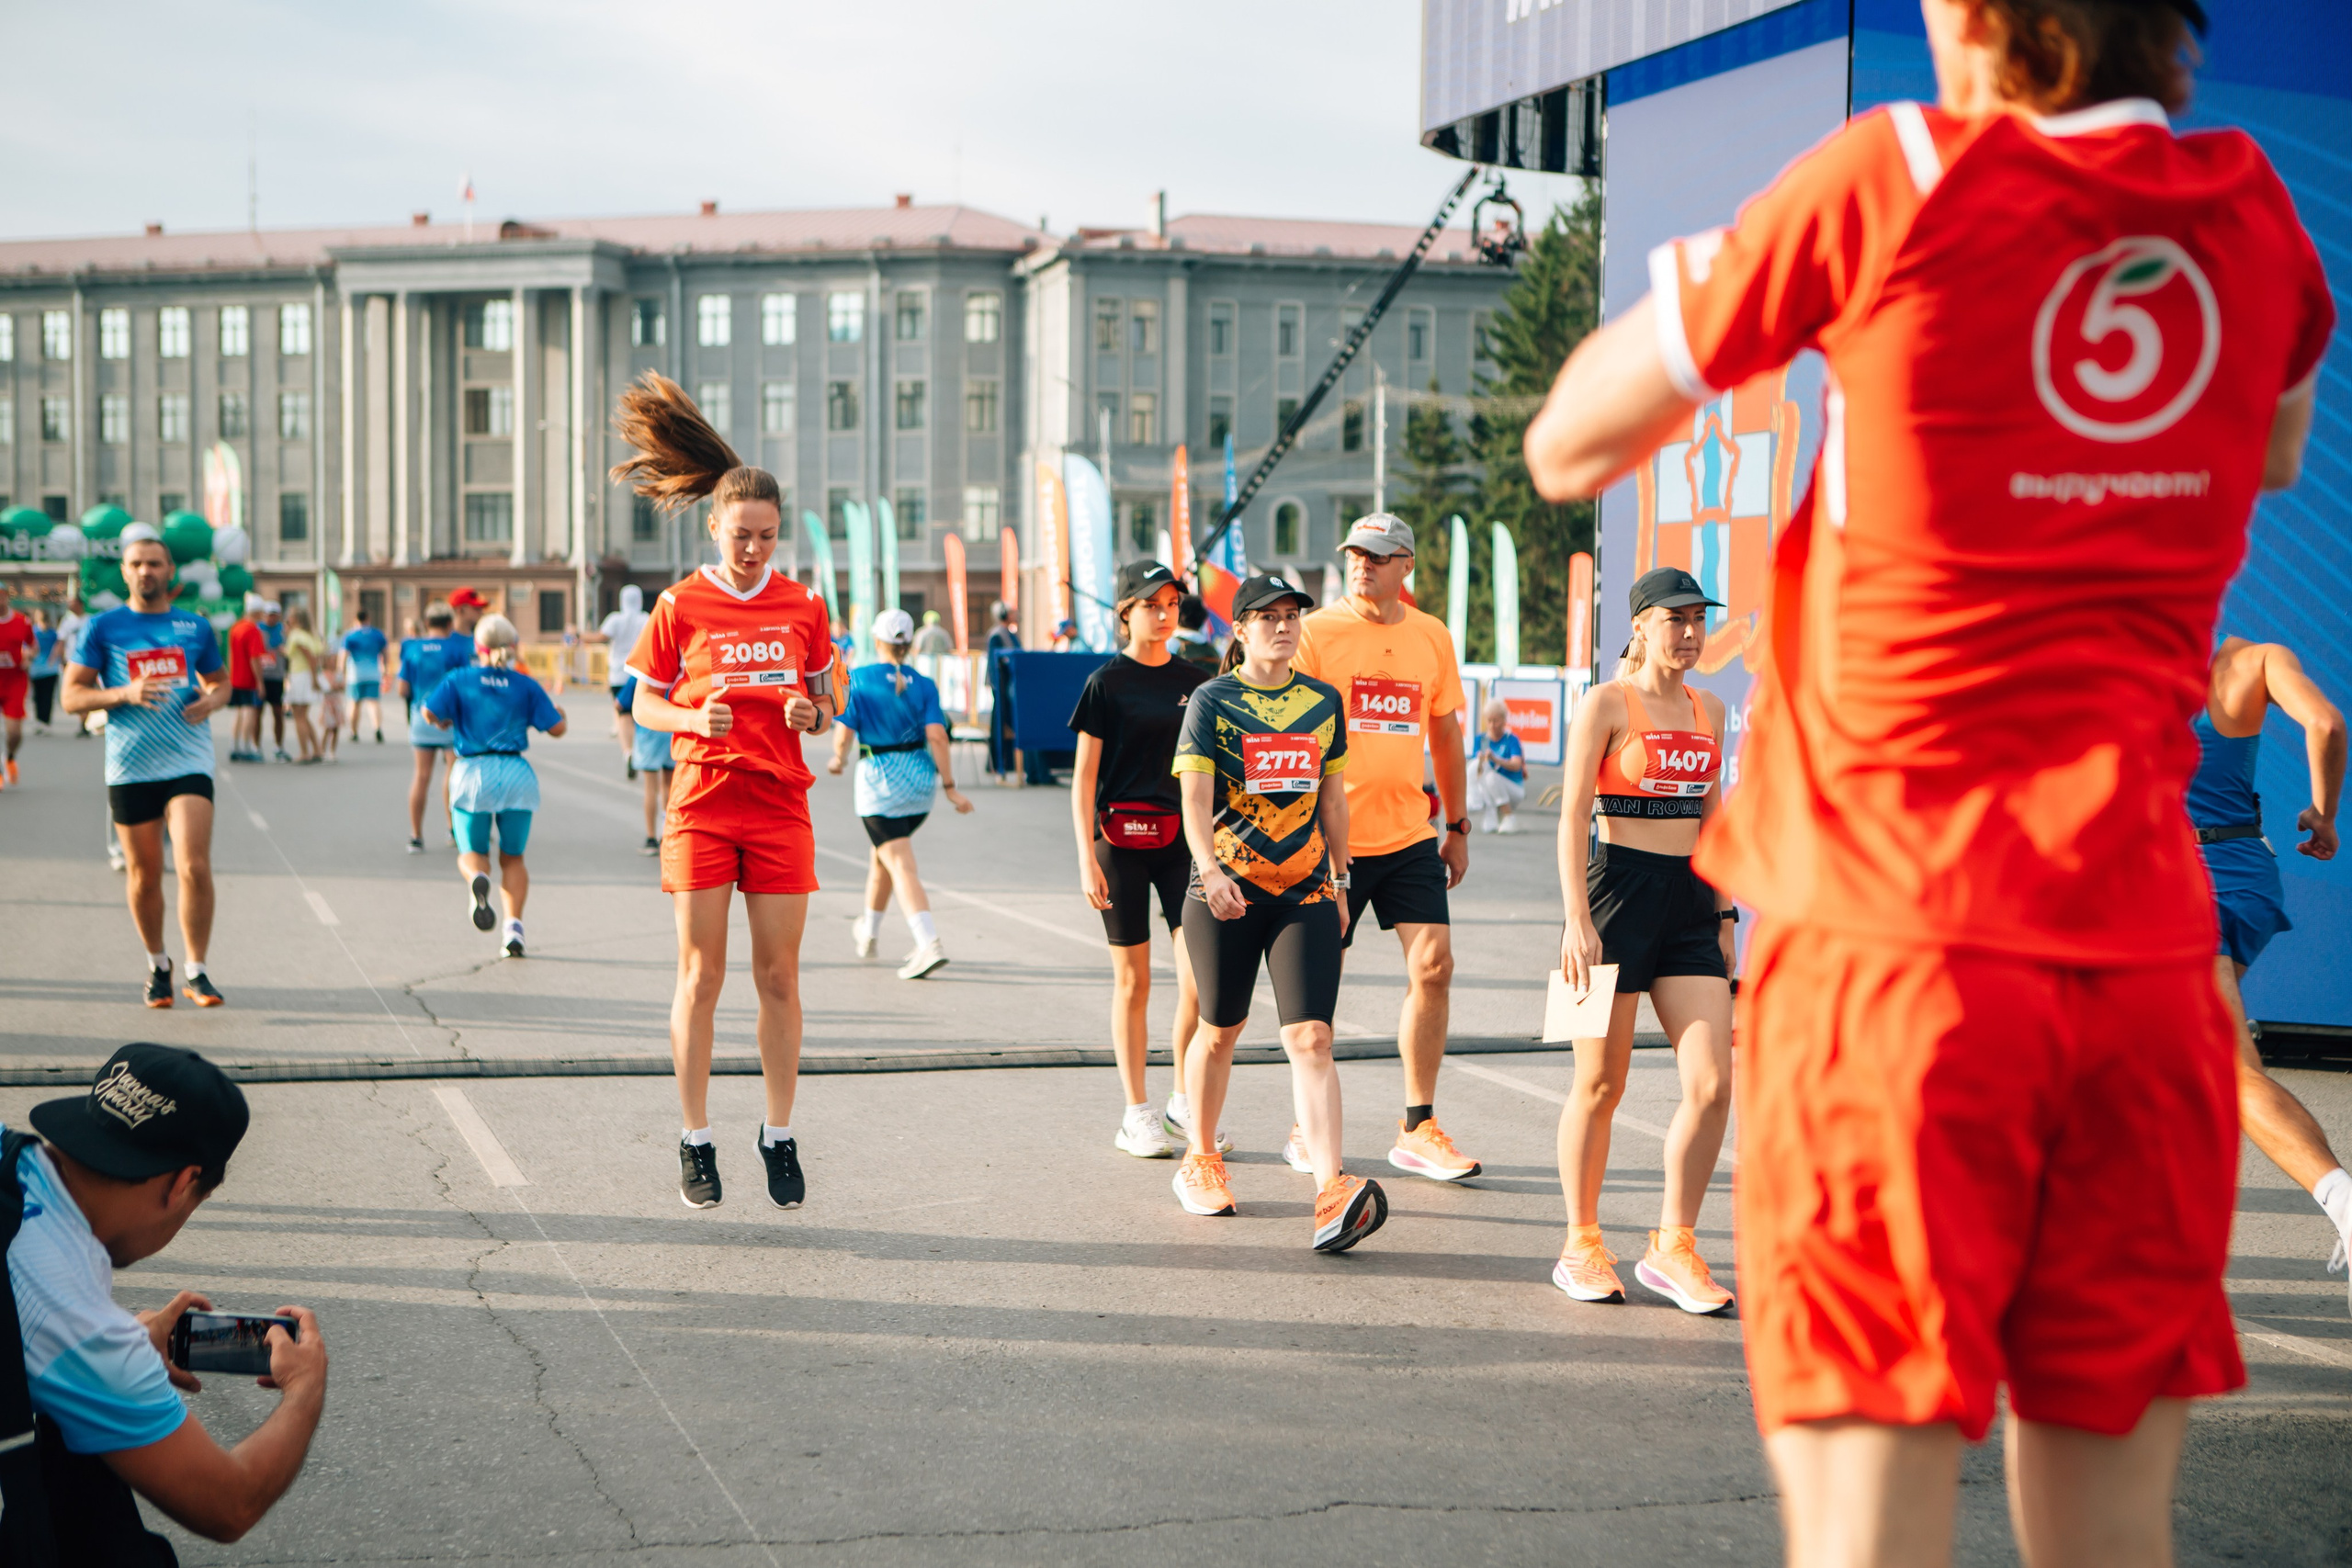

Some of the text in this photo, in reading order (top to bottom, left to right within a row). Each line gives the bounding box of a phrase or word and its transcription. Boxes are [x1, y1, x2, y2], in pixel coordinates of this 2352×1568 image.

[719, 640, 786, 663] 2080
[1361, 694, 1410, 715] 1408
[1255, 750, 1312, 770] 2772
[1657, 750, 1711, 772] 1407
